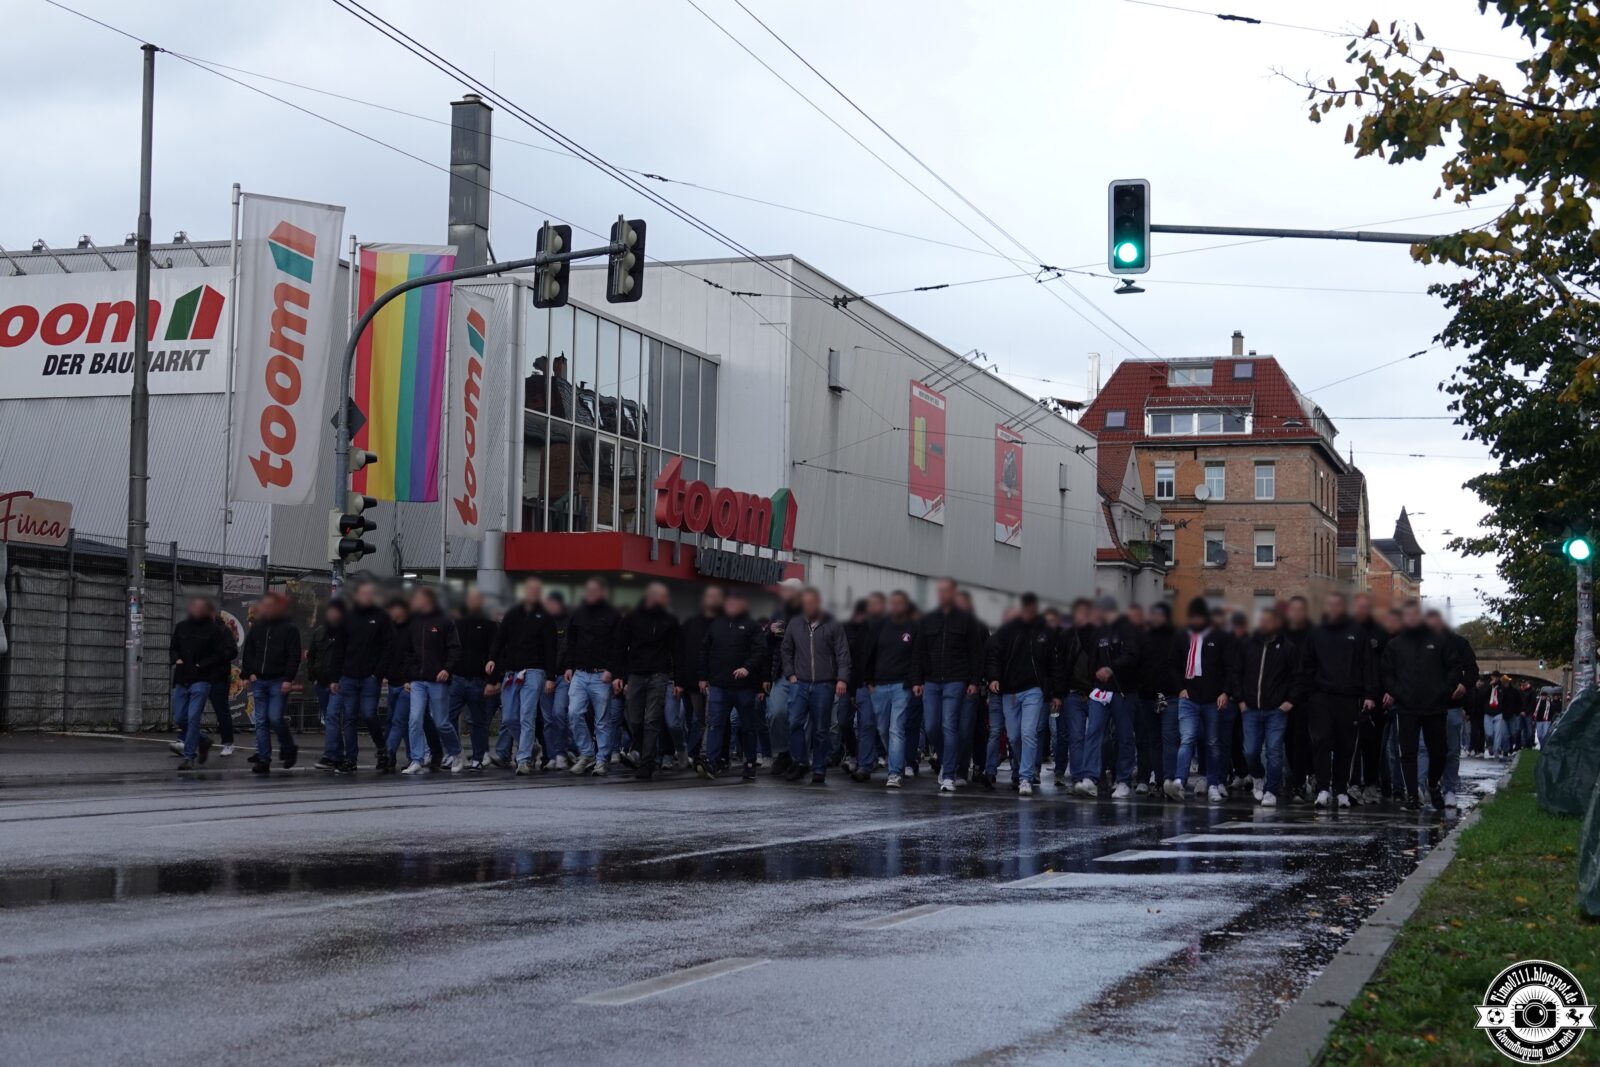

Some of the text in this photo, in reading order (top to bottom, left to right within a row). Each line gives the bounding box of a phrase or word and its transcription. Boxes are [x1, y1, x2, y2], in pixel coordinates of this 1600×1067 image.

[0, 299, 162, 348] oom
[42, 353, 85, 376] DER
[248, 282, 311, 489] toom
[453, 357, 483, 527] toom
[0, 490, 66, 543] Finca
[655, 456, 772, 547] toom
[703, 549, 730, 579] DER
